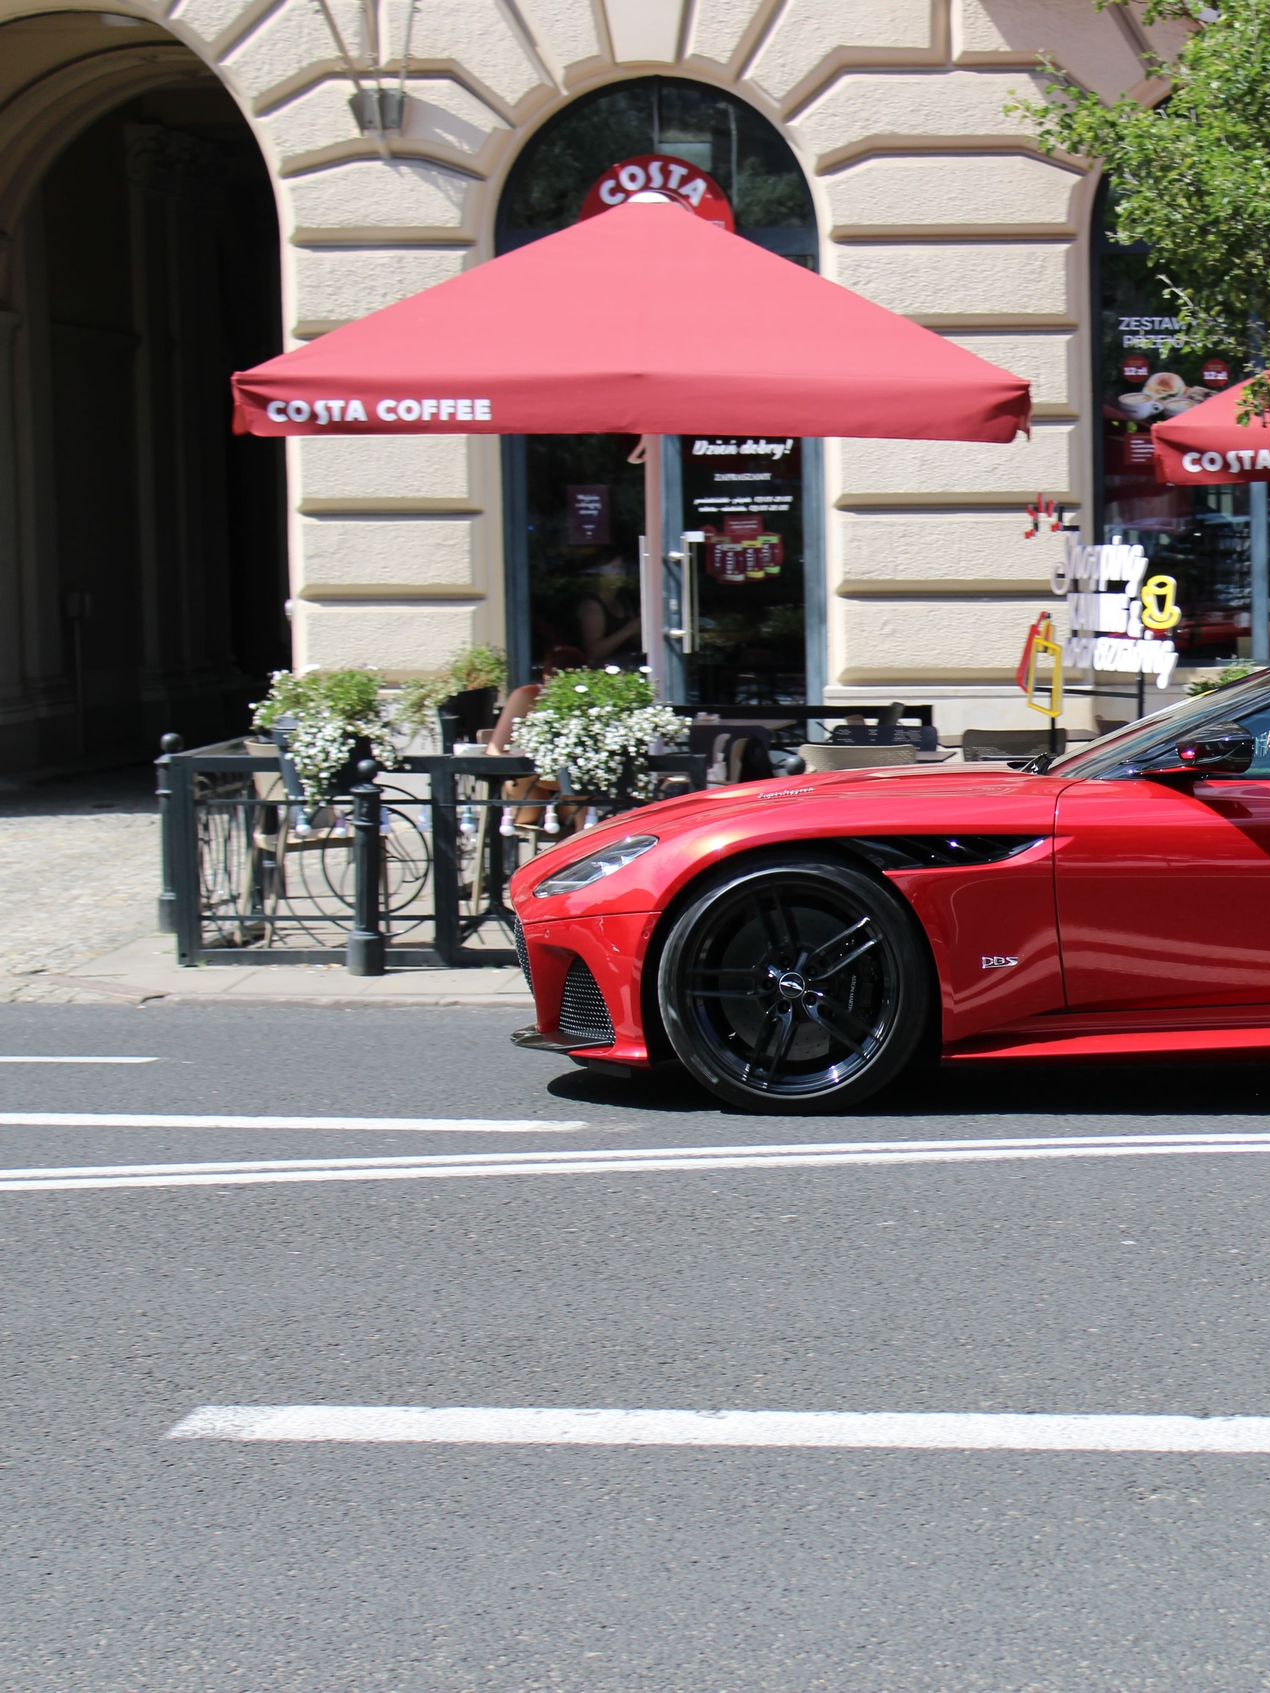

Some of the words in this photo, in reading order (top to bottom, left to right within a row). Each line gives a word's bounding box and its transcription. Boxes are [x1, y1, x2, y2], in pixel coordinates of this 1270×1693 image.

[599, 161, 707, 206] COSTA
[266, 399, 369, 425] COSTA
[376, 398, 492, 423] COFFEE
[981, 956, 1019, 969] DBS
